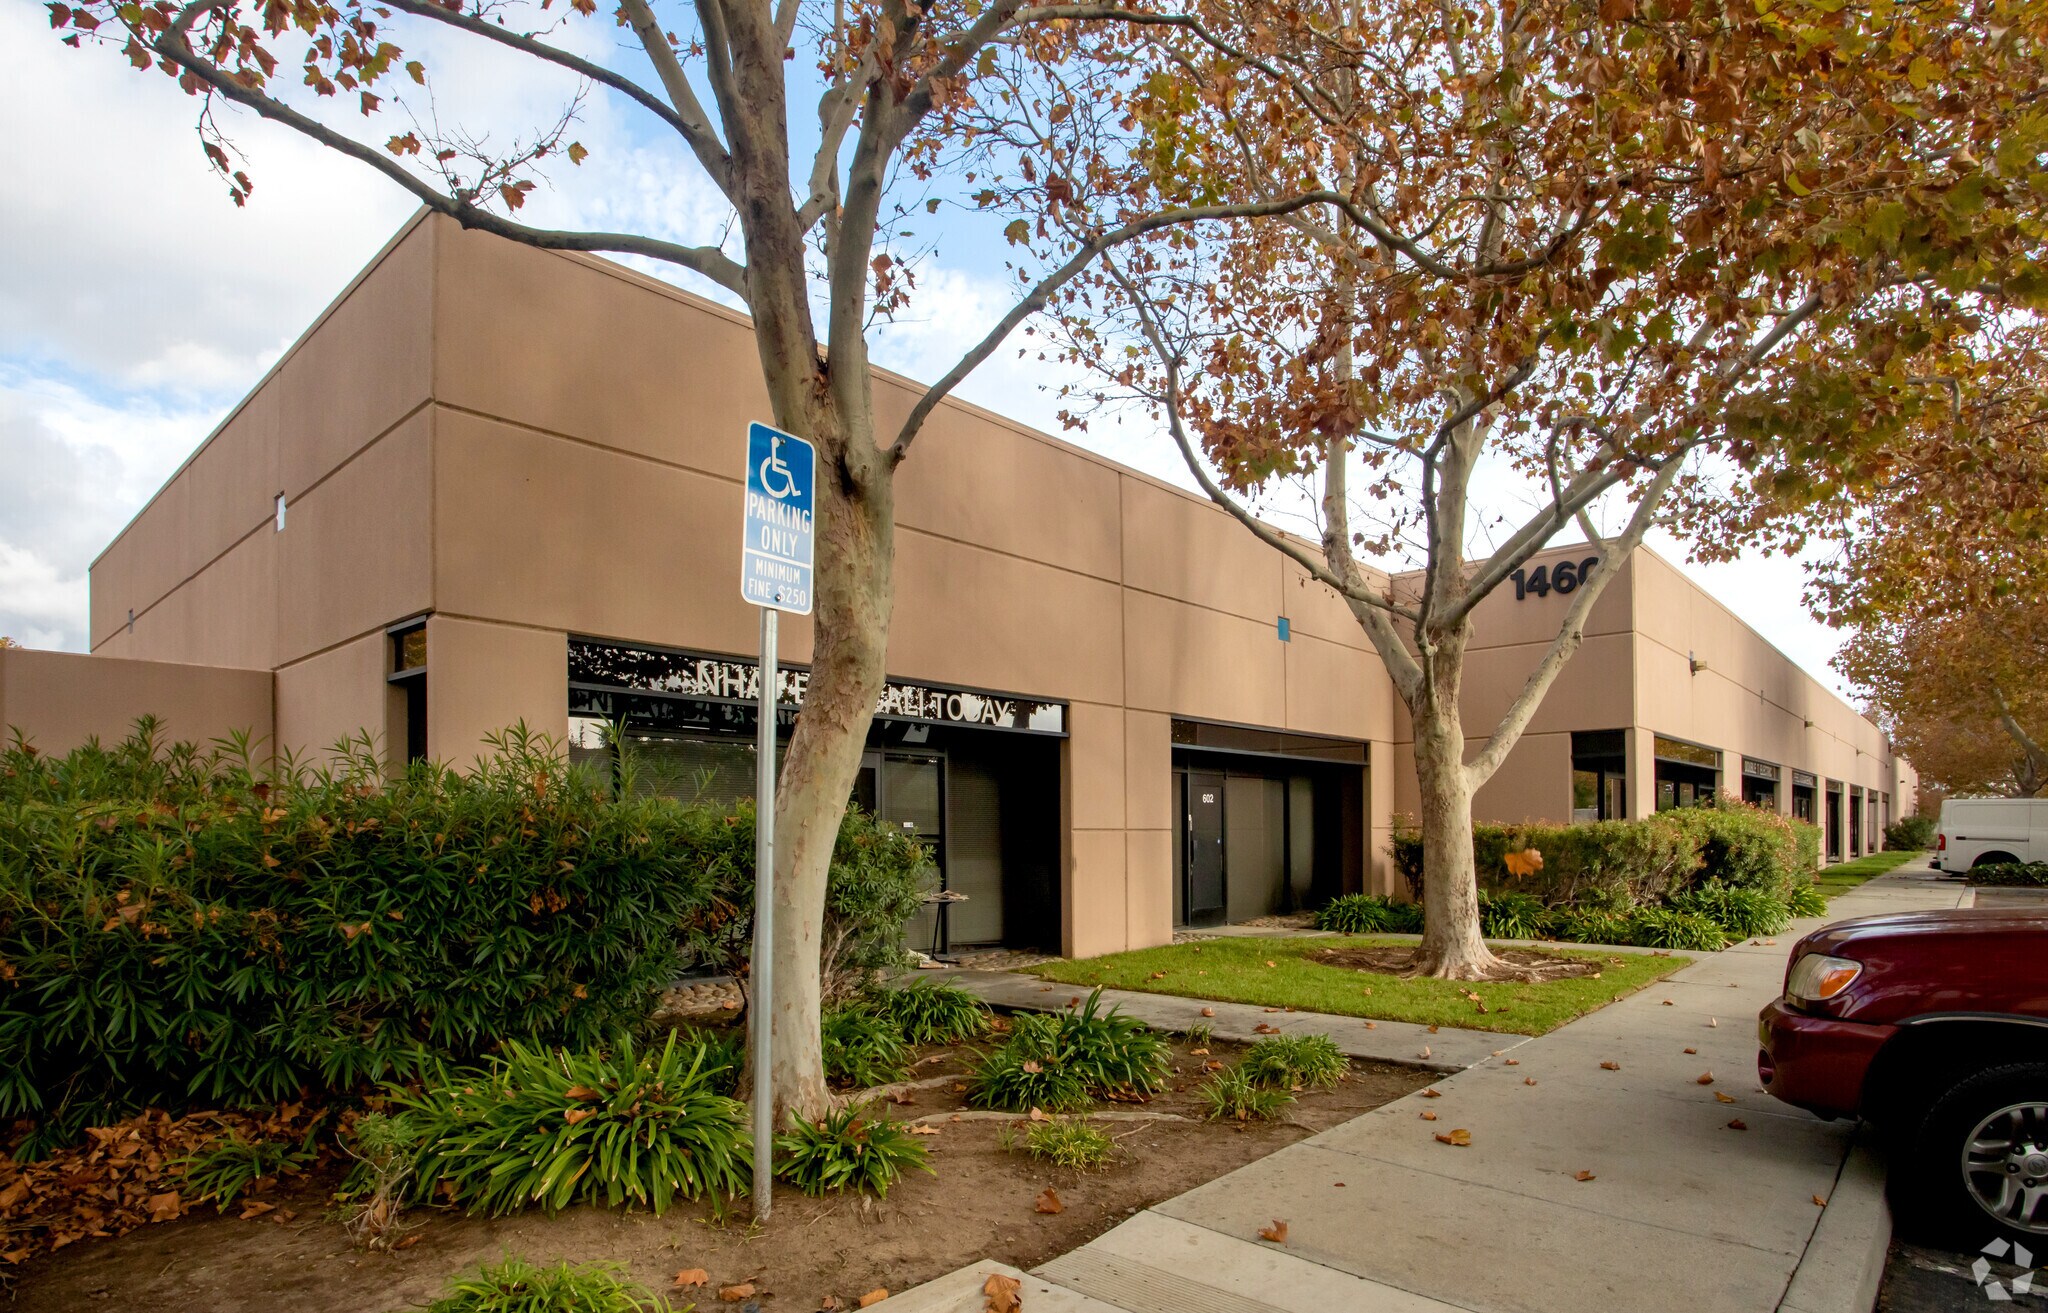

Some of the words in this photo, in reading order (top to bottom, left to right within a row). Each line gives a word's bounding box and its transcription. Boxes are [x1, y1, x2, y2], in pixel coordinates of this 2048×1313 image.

[749, 492, 811, 534] PARKING
[761, 525, 798, 558] ONLY
[755, 558, 800, 585] MINIMUM
[748, 577, 772, 599] FINE
[778, 584, 806, 606] $250
[696, 661, 809, 704] NHAE
[874, 685, 925, 719] ALI
[931, 691, 1010, 726] TODAY
[1202, 793, 1214, 803] 602
